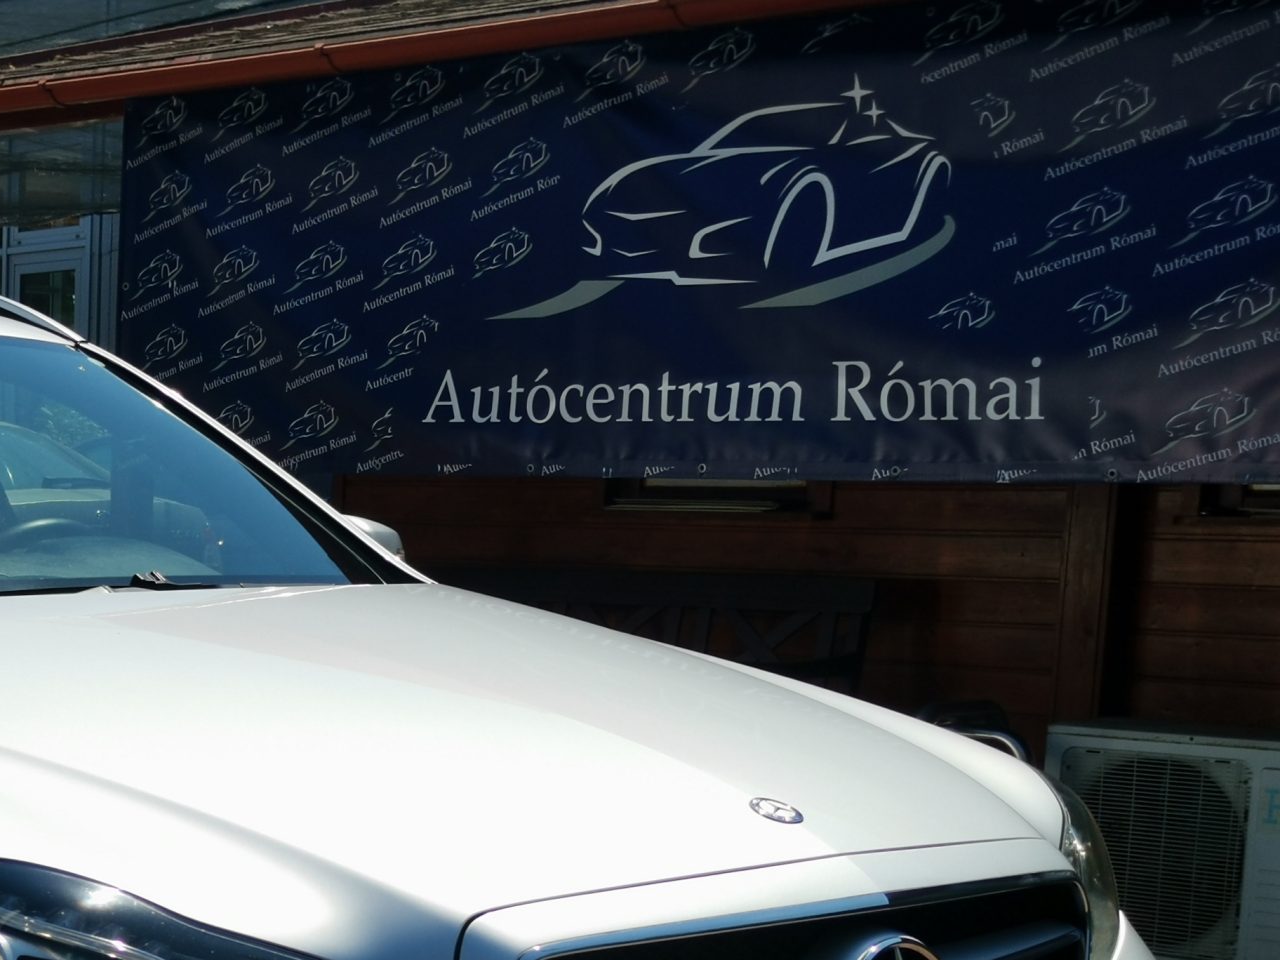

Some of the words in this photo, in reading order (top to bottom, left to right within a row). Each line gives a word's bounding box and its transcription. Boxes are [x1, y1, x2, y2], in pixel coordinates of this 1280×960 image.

[463, 101, 529, 139] Autócentrum
[531, 82, 565, 106] Római
[563, 90, 633, 128] Autócentrum
[635, 73, 669, 96] Római
[1001, 128, 1045, 156] Római
[1043, 141, 1137, 181] Autócentrum
[1140, 115, 1189, 144] Római
[205, 208, 264, 239] Autócentrum
[265, 193, 293, 214] Római
[292, 202, 348, 235] Autócentrum
[349, 185, 379, 208] Római
[379, 193, 440, 229] Autócentrum
[442, 177, 472, 199] Római
[470, 187, 534, 222] Autócentrum
[536, 174, 561, 192] Róm
[1013, 244, 1106, 285] Autócentrum
[1110, 224, 1157, 251] Római
[1152, 235, 1251, 278] Autócentrum
[197, 290, 246, 319] Autócentrum
[247, 275, 276, 296] Római
[272, 285, 333, 316] Autócentrum
[335, 270, 365, 291] Római
[362, 281, 422, 313] Autócentrum
[424, 264, 455, 287] Római
[1112, 323, 1158, 350] Római
[1158, 338, 1256, 378] Autócentrum
[202, 365, 257, 393] Autócentrum
[259, 354, 284, 371] Római
[285, 361, 335, 393] Autócentrum
[337, 349, 369, 370] Római
[364, 367, 414, 392] Autócentr
[421, 367, 805, 424] Autócentrum
[830, 356, 1045, 423] Római
[278, 446, 328, 468] utócentrum
[329, 432, 357, 453] Római
[1090, 429, 1136, 454] Római
[1136, 445, 1232, 483] Autócentrum
[1237, 433, 1280, 454] Róma
